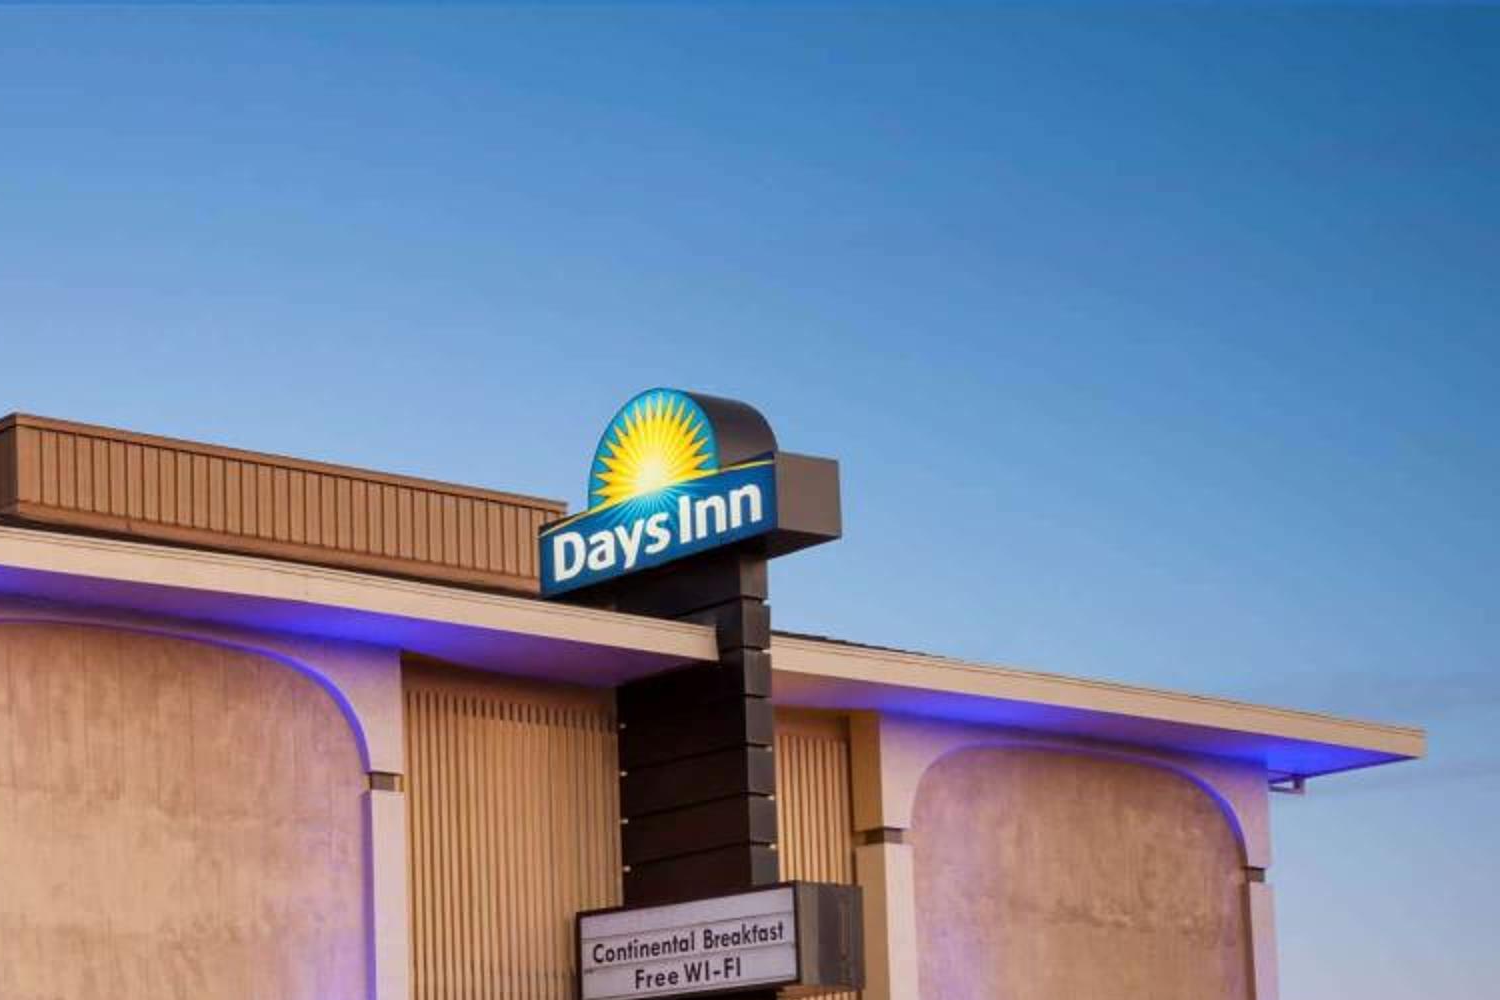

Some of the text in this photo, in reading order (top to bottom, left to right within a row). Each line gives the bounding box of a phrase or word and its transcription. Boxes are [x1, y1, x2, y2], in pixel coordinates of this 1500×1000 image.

[553, 483, 762, 583] Days Inn
[592, 921, 784, 963] Continental Breakfast
[634, 957, 741, 989] Free WI-FI
